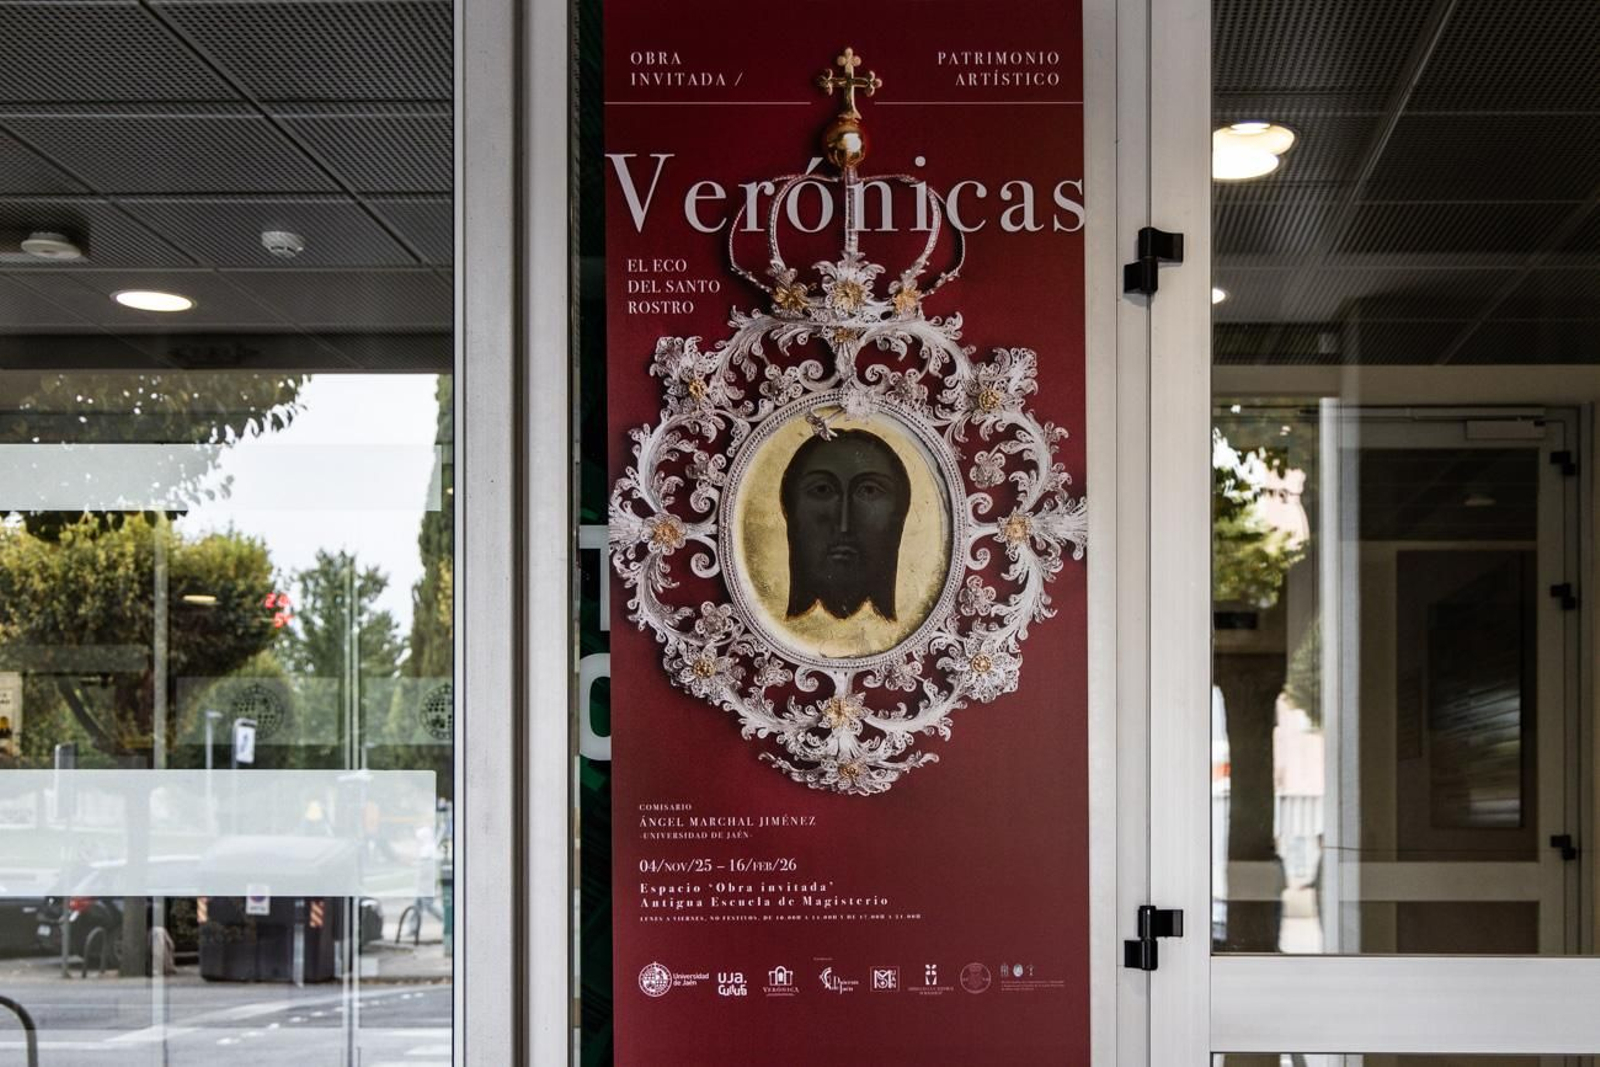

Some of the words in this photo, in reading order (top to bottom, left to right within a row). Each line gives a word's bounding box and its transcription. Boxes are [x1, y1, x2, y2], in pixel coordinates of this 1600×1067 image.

[630, 51, 682, 65] OBRA
[938, 51, 1060, 66] PATRIMONIO
[631, 72, 727, 86] INVITADA
[955, 69, 1060, 86] ARTÍSTICO
[605, 153, 1086, 234] Verónicas
[627, 258, 648, 272] EL
[653, 258, 688, 272] ECO
[628, 279, 662, 293] DEL
[666, 279, 721, 293] SANTO
[628, 300, 694, 315] ROSTRO
[639, 803, 693, 812] COMISARIO
[639, 815, 684, 828] ÁNGEL
[689, 816, 754, 828] MARCHAL
[758, 814, 817, 828] JIMÉNEZ
[711, 831, 724, 839] DE
[639, 858, 713, 873] 04/NOV/25
[730, 857, 797, 872] 16/FEB/26
[640, 883, 702, 896] Espacio
[640, 896, 703, 910] Antigua
[711, 896, 770, 907] Escuela
[779, 896, 796, 907] de
[803, 895, 889, 909] Magisterio
[672, 972, 710, 981] Universidad
